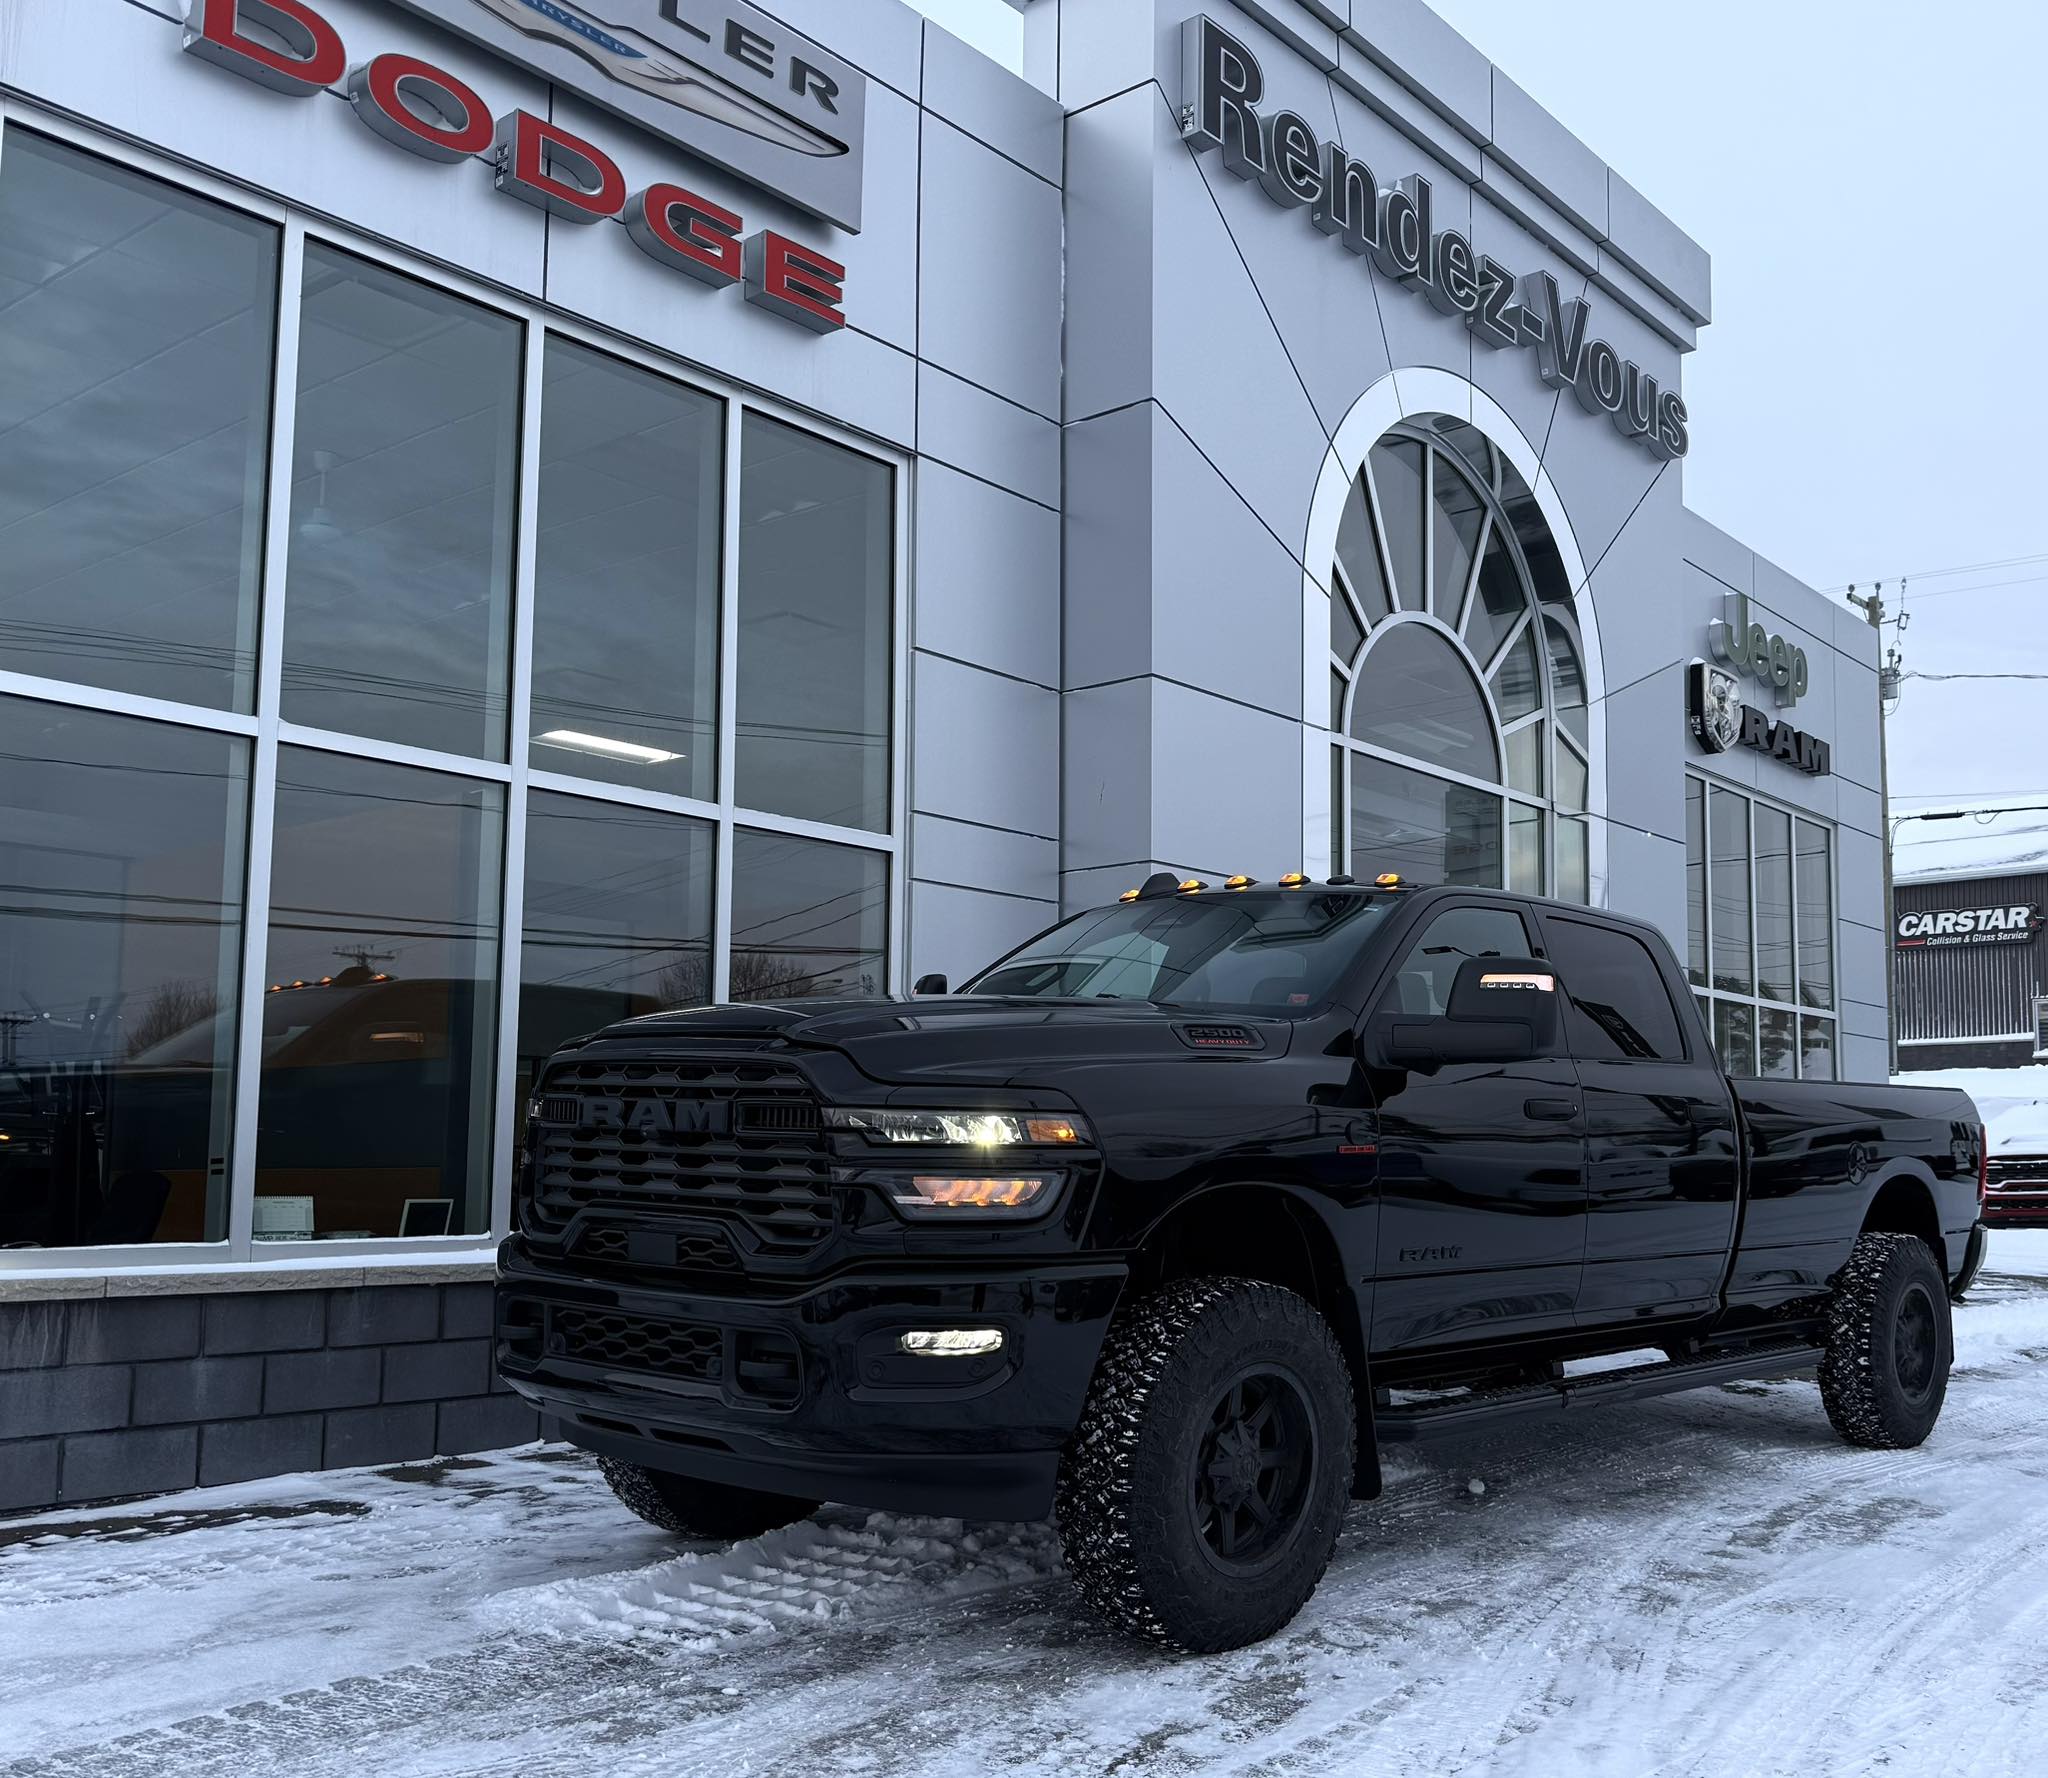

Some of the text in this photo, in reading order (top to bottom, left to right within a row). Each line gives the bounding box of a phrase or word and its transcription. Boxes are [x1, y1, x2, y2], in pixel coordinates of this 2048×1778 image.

[190, 0, 847, 331] DODGE
[1183, 13, 1689, 461] Rendez-Vous
[1712, 593, 1808, 708] Jeep
[1741, 705, 1830, 776] RAM
[1899, 906, 2030, 937] CARSTAR
[1926, 930, 2029, 946] Collision & Glass Service
[1189, 1027, 1246, 1038] 2500
[582, 1096, 729, 1133] RAM
[1399, 1246, 1464, 1262] RAM
